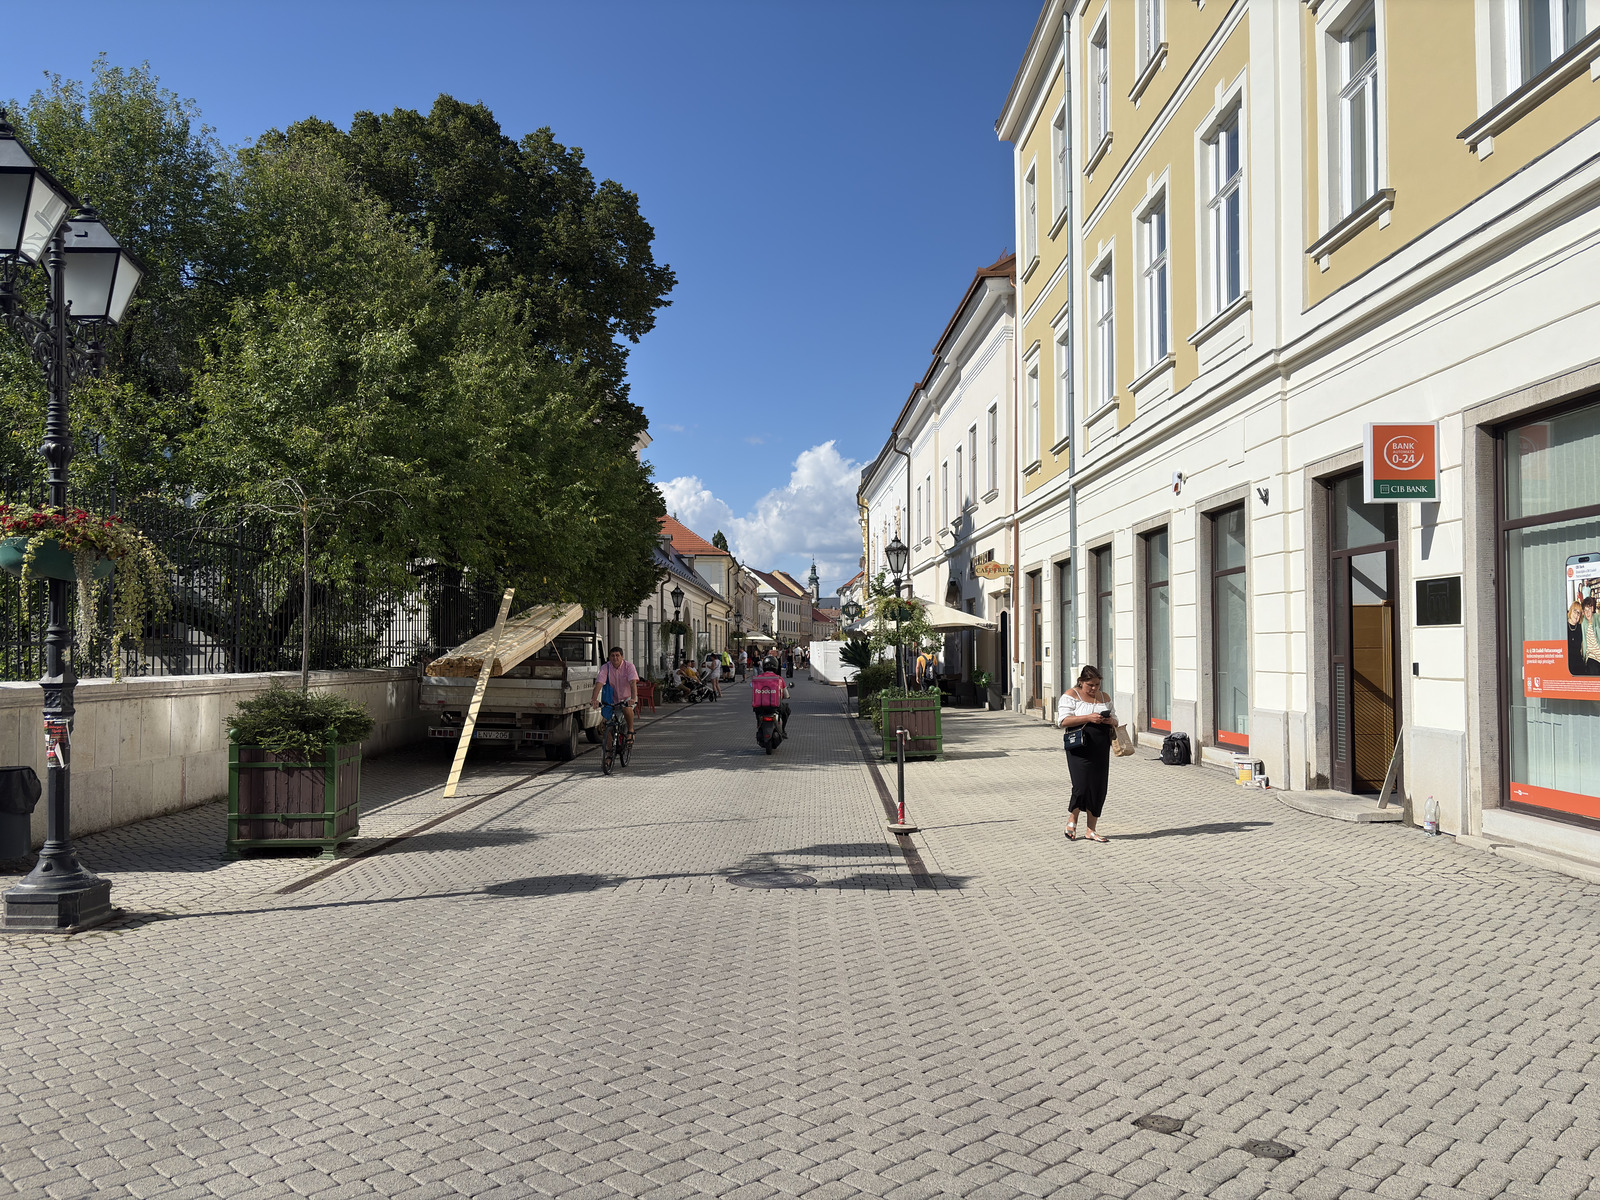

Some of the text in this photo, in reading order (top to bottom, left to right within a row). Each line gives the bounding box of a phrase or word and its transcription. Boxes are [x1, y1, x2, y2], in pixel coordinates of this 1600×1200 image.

[1392, 442, 1415, 450] BANK
[1392, 454, 1415, 464] 0-24
[1390, 485, 1428, 493] CIB BANK
